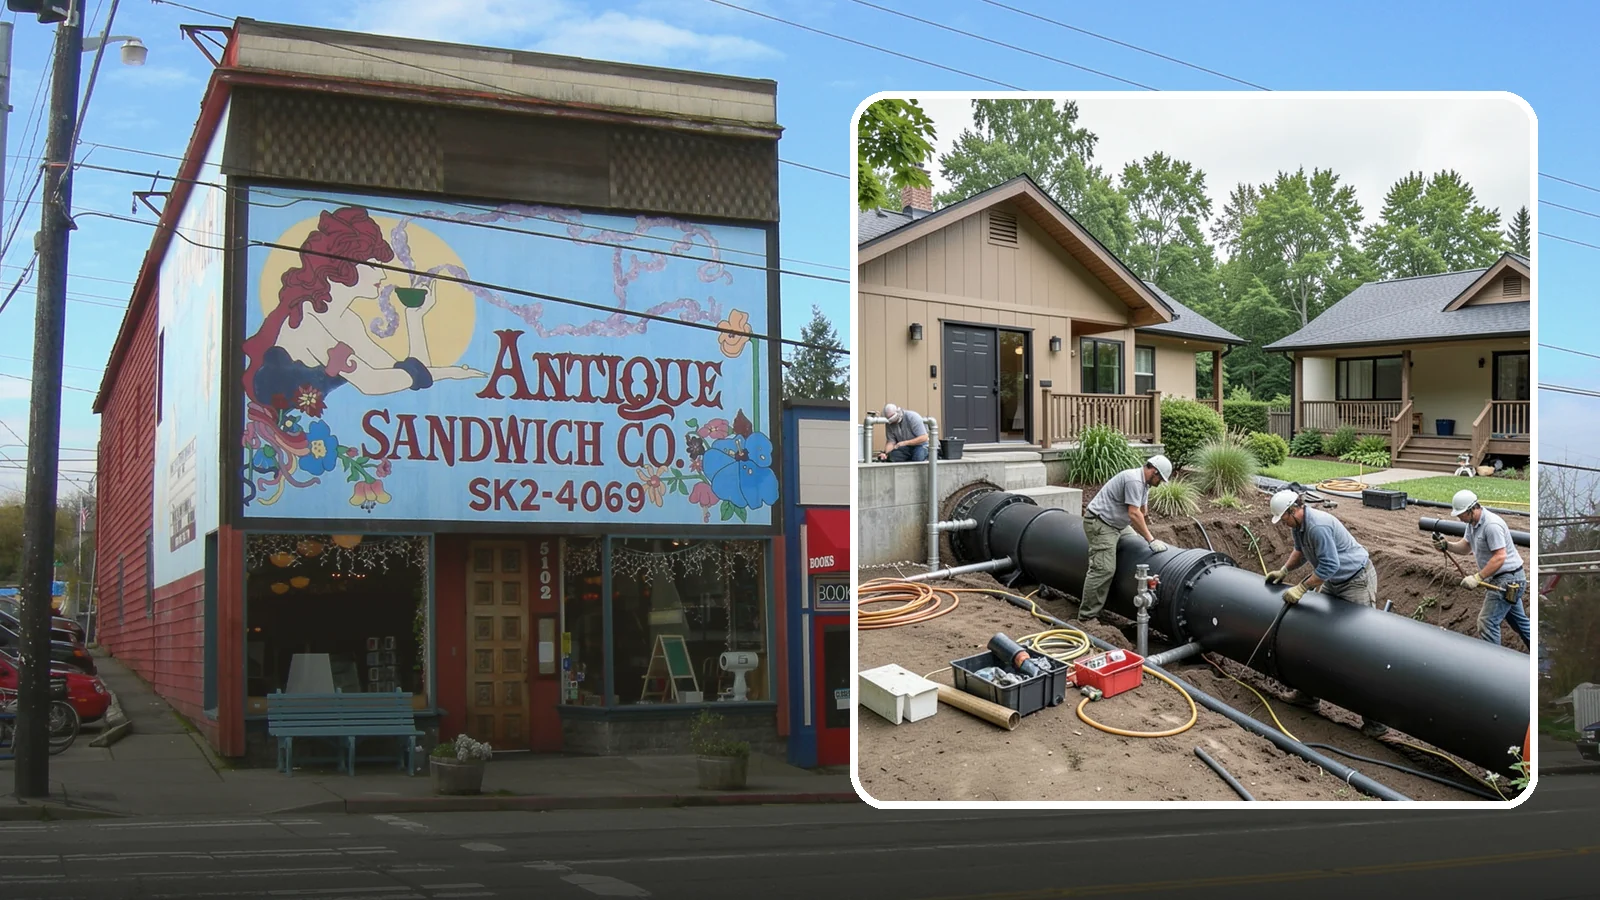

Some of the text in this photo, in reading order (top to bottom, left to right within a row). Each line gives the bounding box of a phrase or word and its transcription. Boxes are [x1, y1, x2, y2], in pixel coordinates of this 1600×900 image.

[476, 329, 723, 420] ANTIQUE
[361, 408, 685, 469] SANDWICH CO.
[468, 478, 645, 513] SK2-4069
[540, 542, 551, 599] 5102
[809, 555, 835, 569] BOOKS
